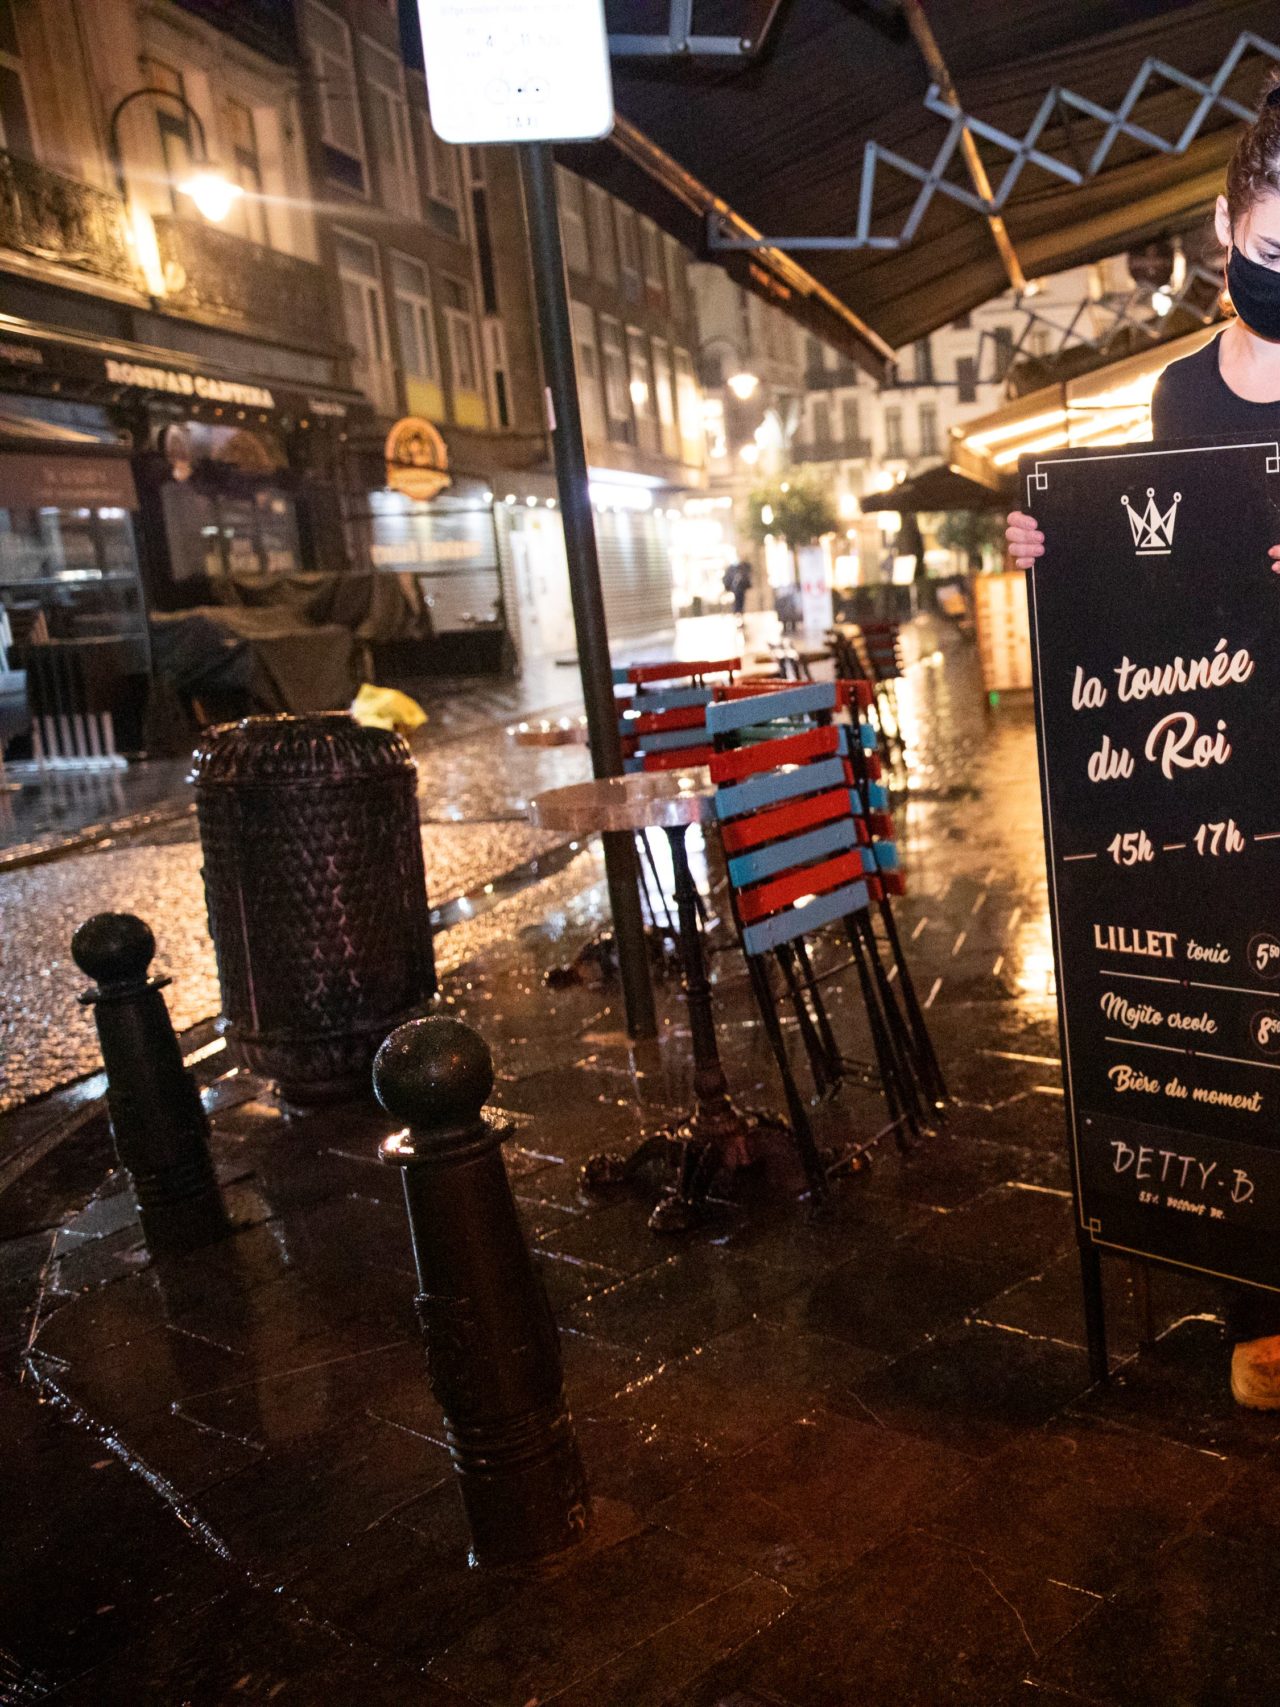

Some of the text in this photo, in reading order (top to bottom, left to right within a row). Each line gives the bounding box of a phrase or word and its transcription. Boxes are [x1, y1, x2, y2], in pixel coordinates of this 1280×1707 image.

[1072, 638, 1254, 710] la tournée
[1088, 711, 1231, 783] du Roi
[1107, 830, 1154, 866] 15h
[1193, 818, 1245, 856] 17h
[1093, 924, 1178, 958] LILLET
[1187, 938, 1231, 964] tonic
[1100, 991, 1163, 1030] Mojito
[1167, 1012, 1218, 1034] creole
[1108, 1064, 1264, 1113] Bière du moment
